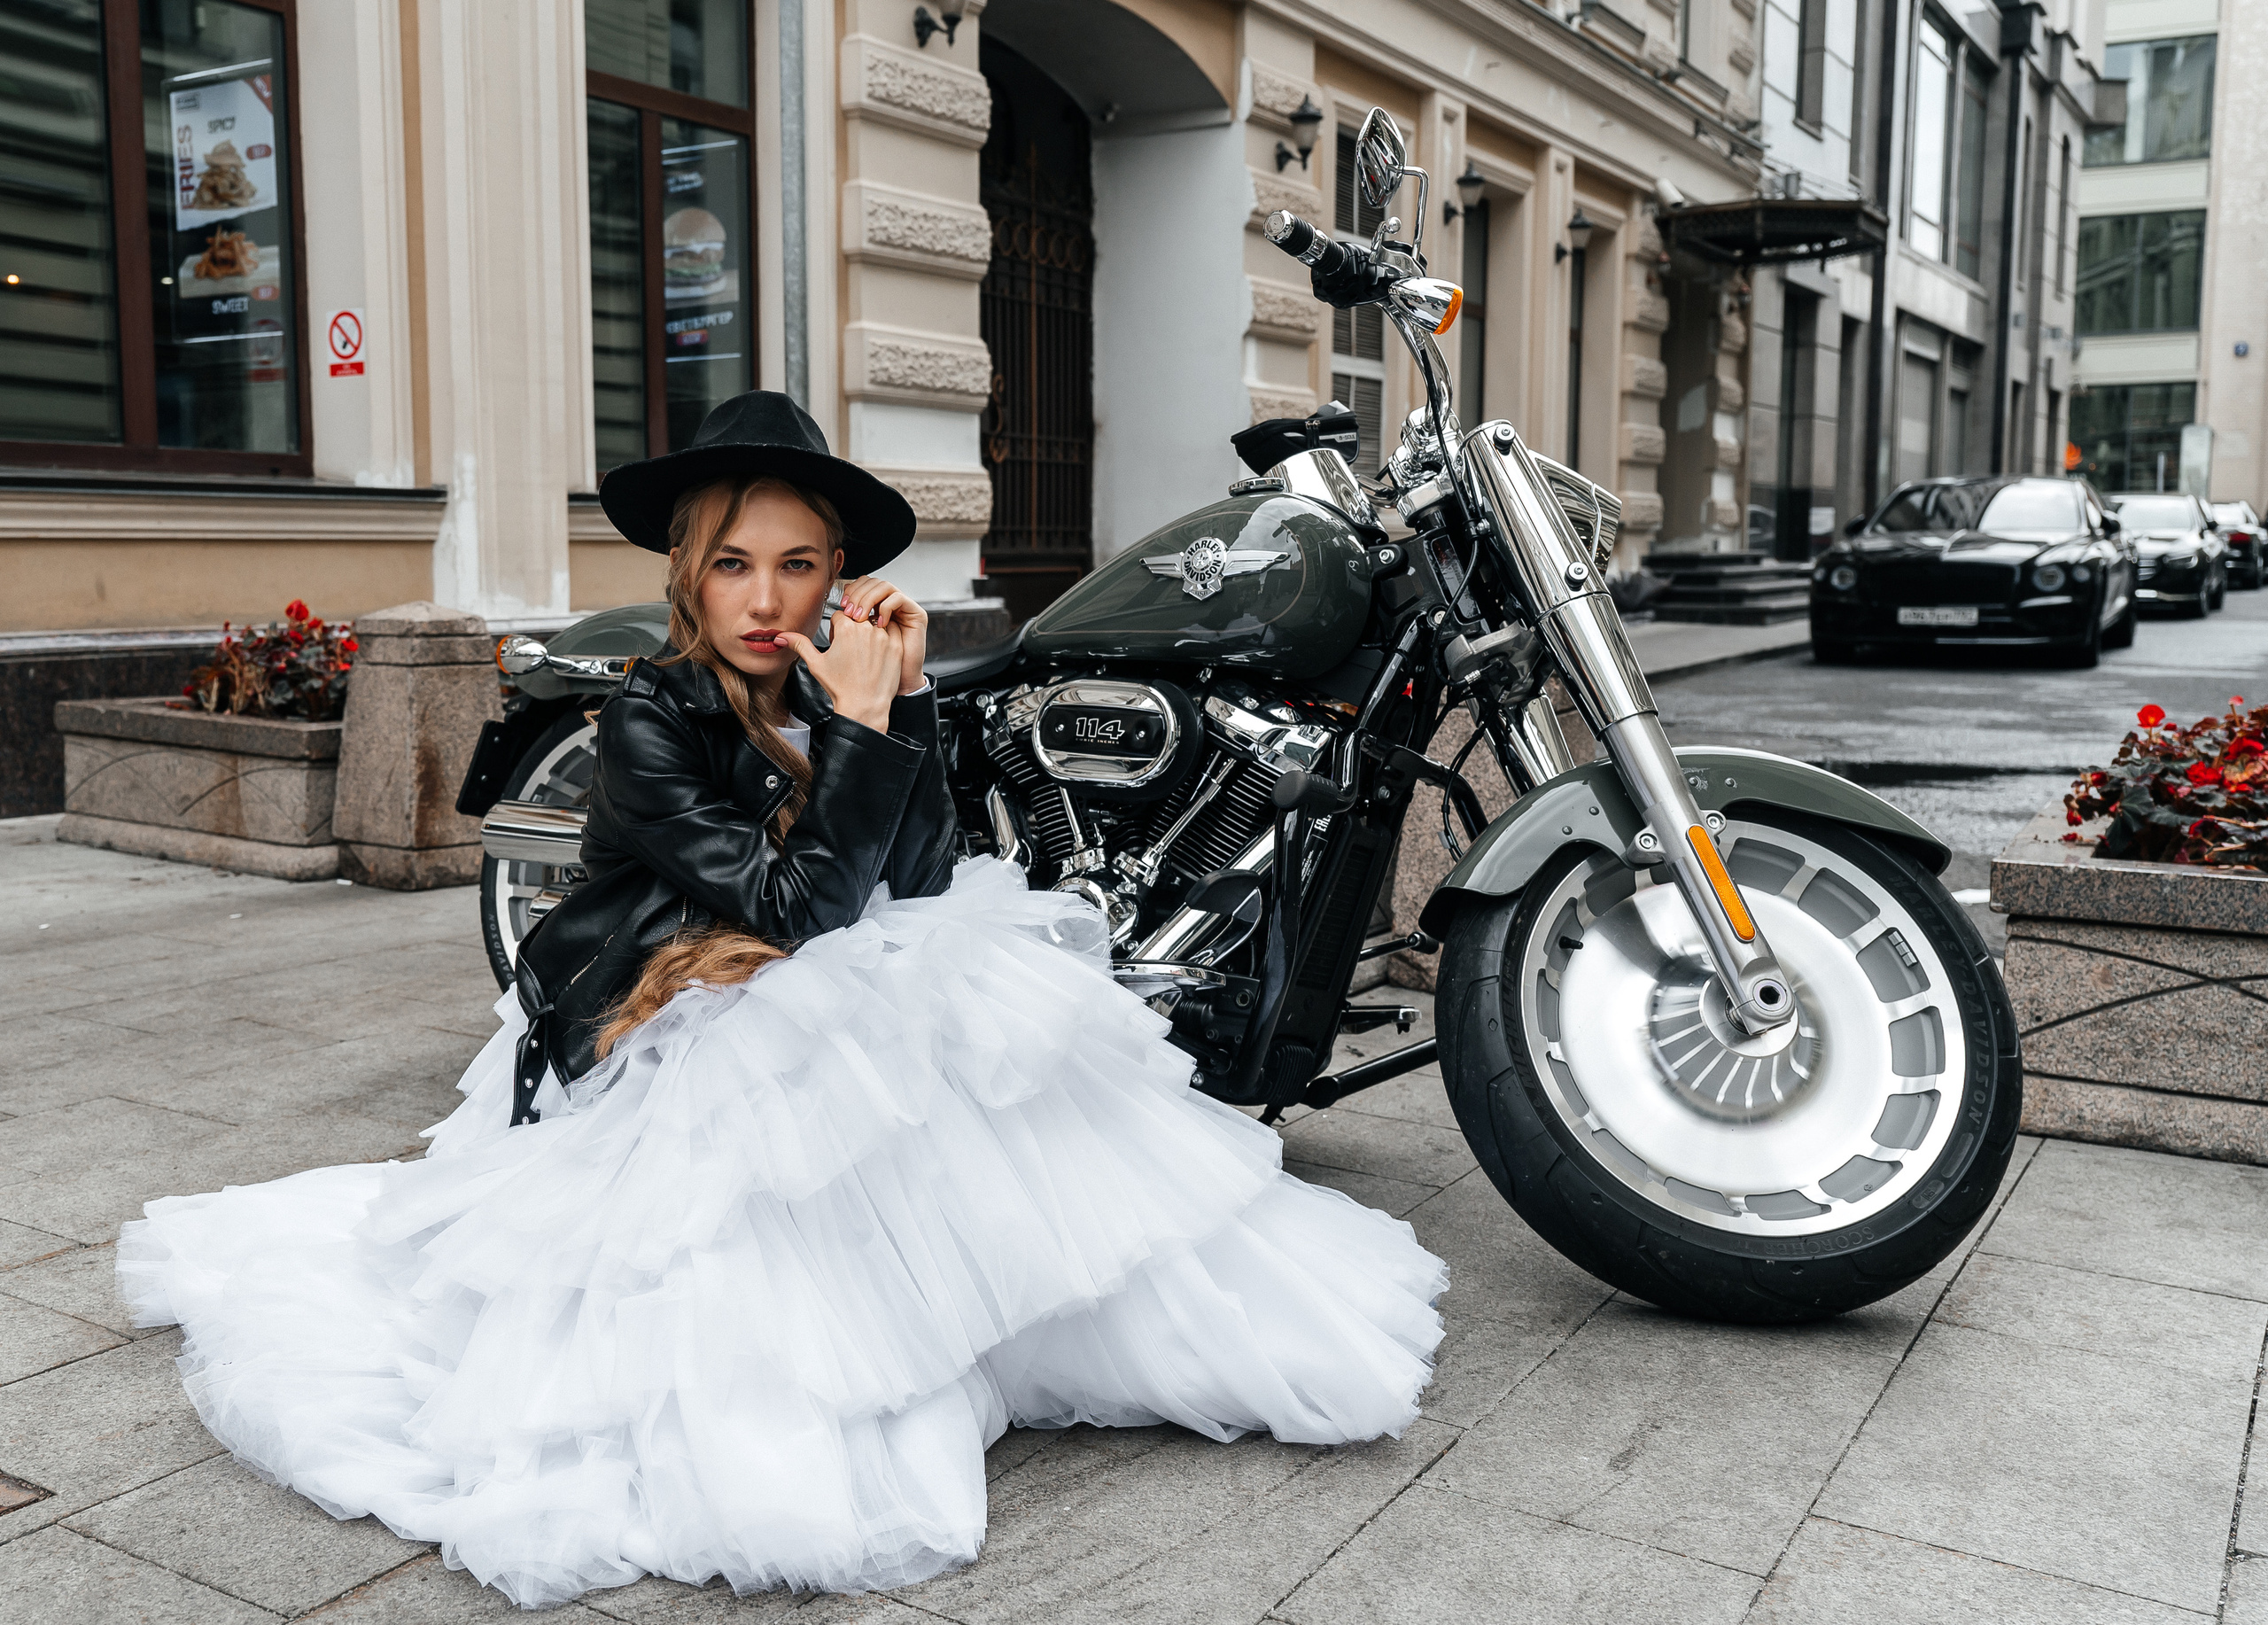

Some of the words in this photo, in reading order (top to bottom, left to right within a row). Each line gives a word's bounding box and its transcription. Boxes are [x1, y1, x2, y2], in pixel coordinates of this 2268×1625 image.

[207, 116, 237, 134] SPICY
[177, 125, 195, 210] FRIES
[211, 296, 250, 315] SWEET
[1188, 540, 1221, 556] HARLEY
[1184, 560, 1222, 581] DAVIDSON
[1076, 717, 1125, 740] 114
[1503, 959, 1537, 1090] MICHELIN
[1765, 1226, 1875, 1256] SCORCHER
